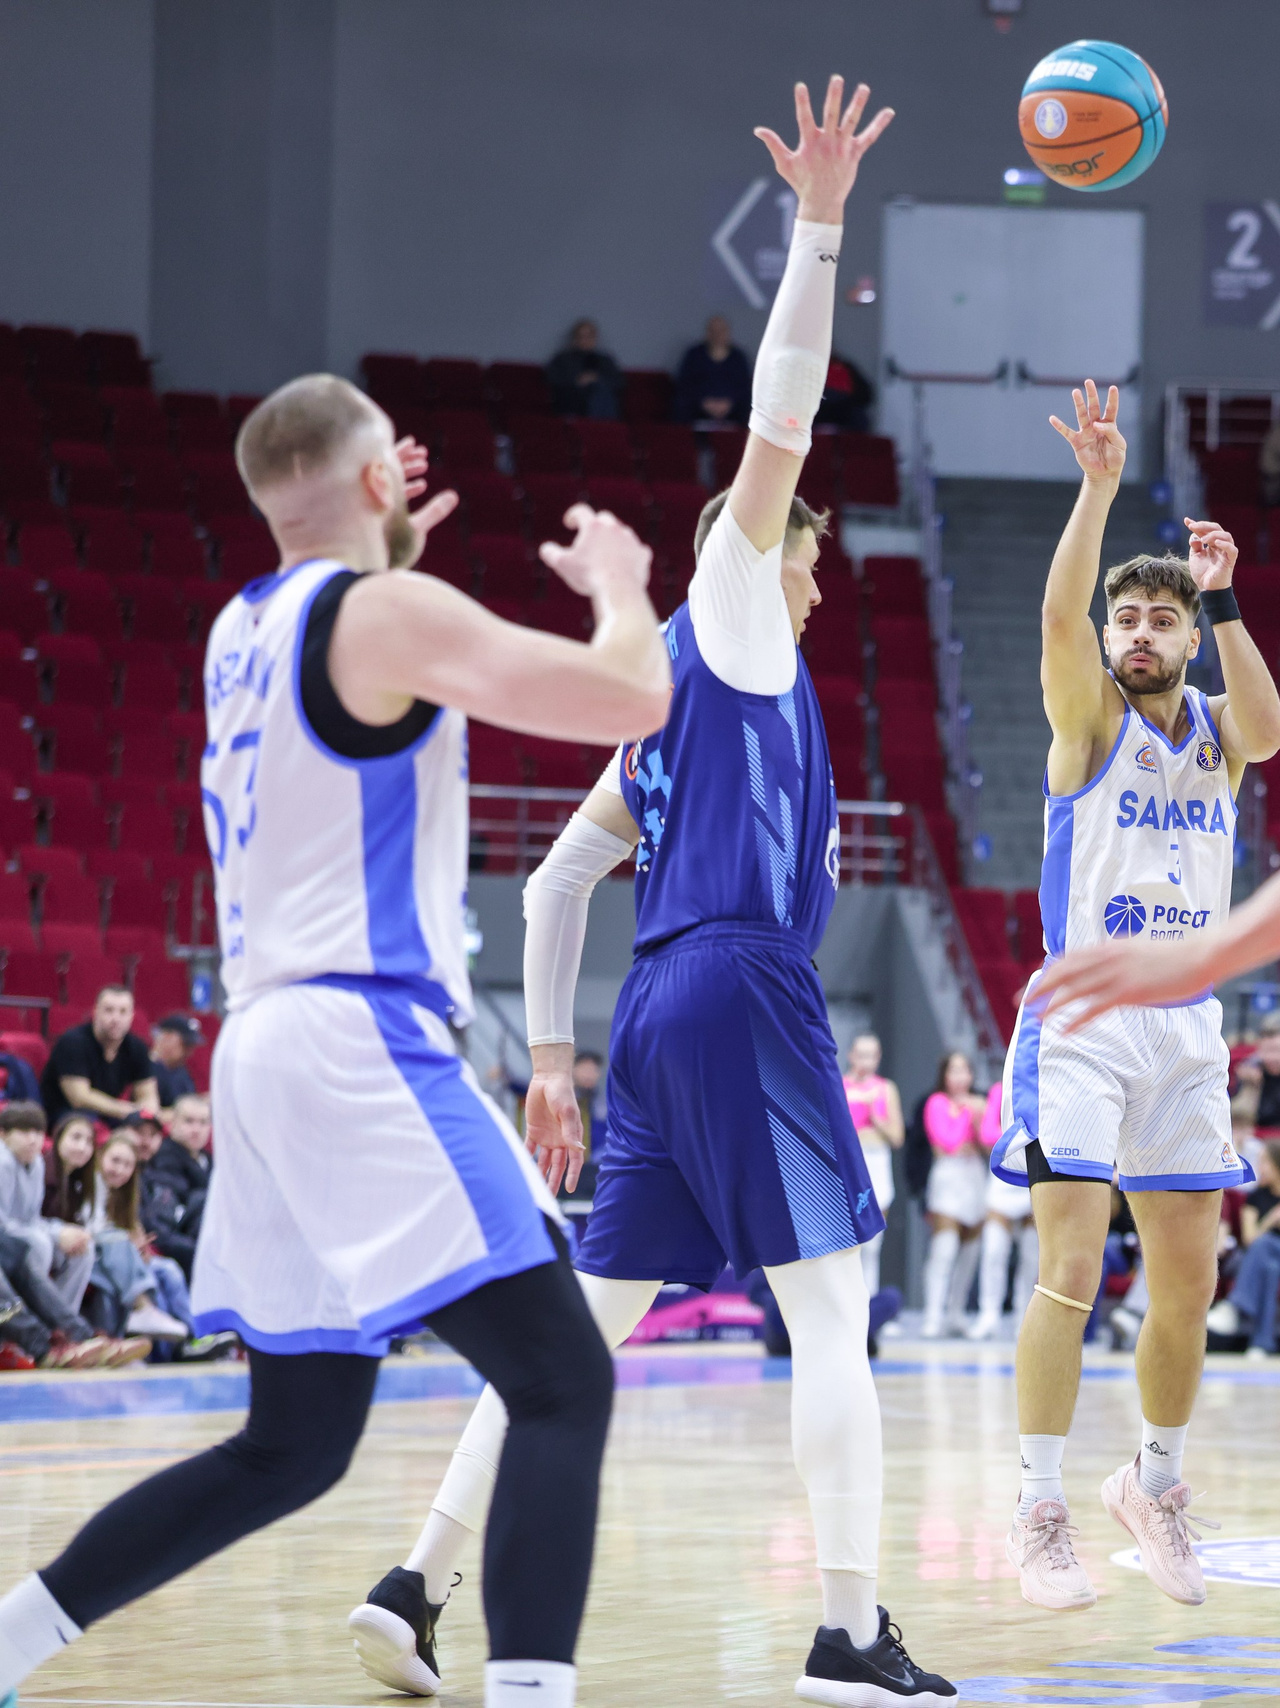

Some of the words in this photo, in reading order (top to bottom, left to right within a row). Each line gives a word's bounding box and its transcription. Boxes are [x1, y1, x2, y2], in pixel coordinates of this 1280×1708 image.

[1226, 209, 1261, 268] 2
[1150, 929, 1184, 941] ВОЛГА
[1051, 1147, 1080, 1157] ZEDO
